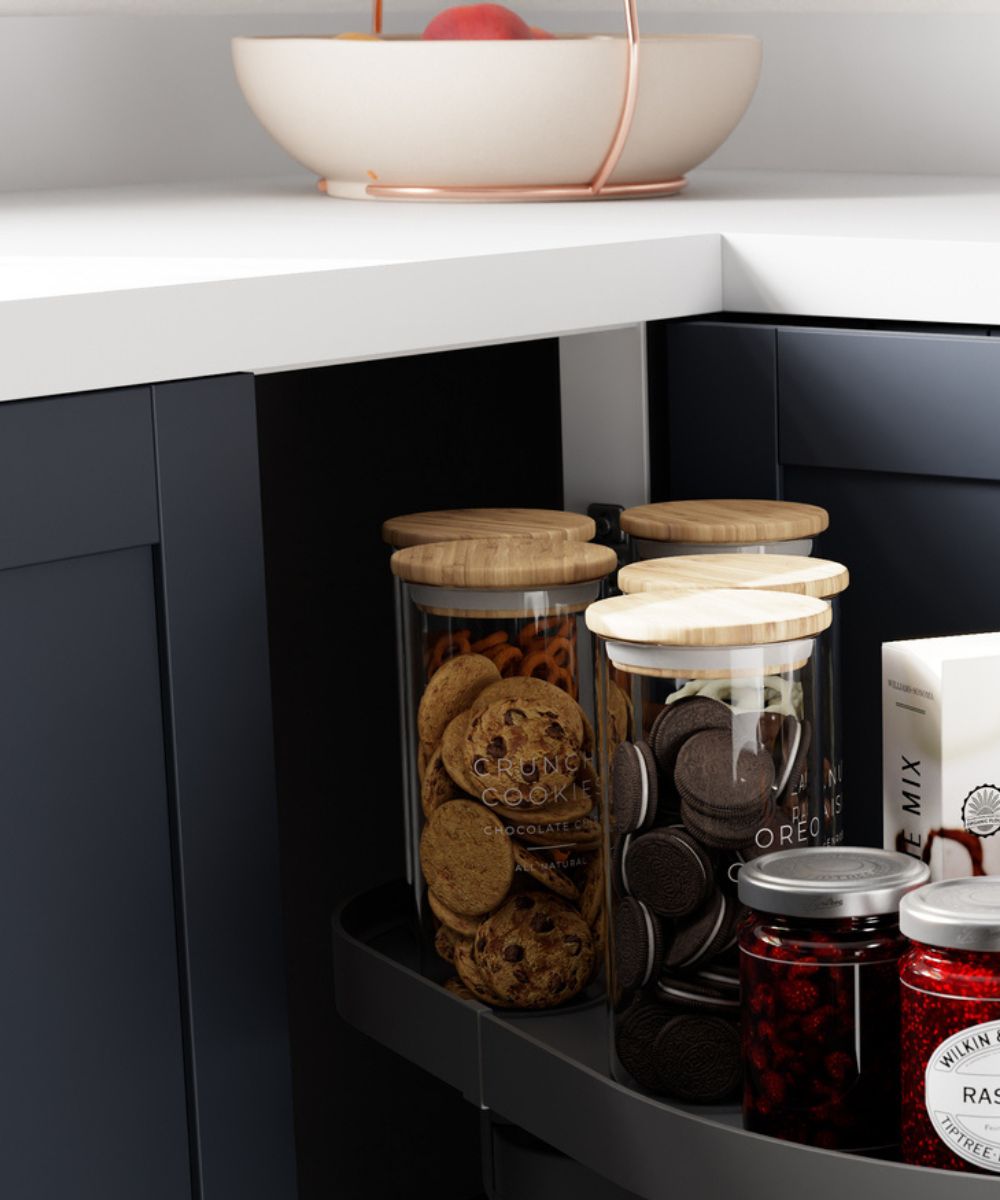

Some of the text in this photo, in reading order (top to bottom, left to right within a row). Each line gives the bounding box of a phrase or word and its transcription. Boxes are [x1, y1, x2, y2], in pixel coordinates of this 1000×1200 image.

[902, 755, 921, 816] MIX
[755, 816, 820, 848] OREO
[939, 1033, 990, 1068] WILKIN
[941, 1115, 993, 1159] TIPTREE
